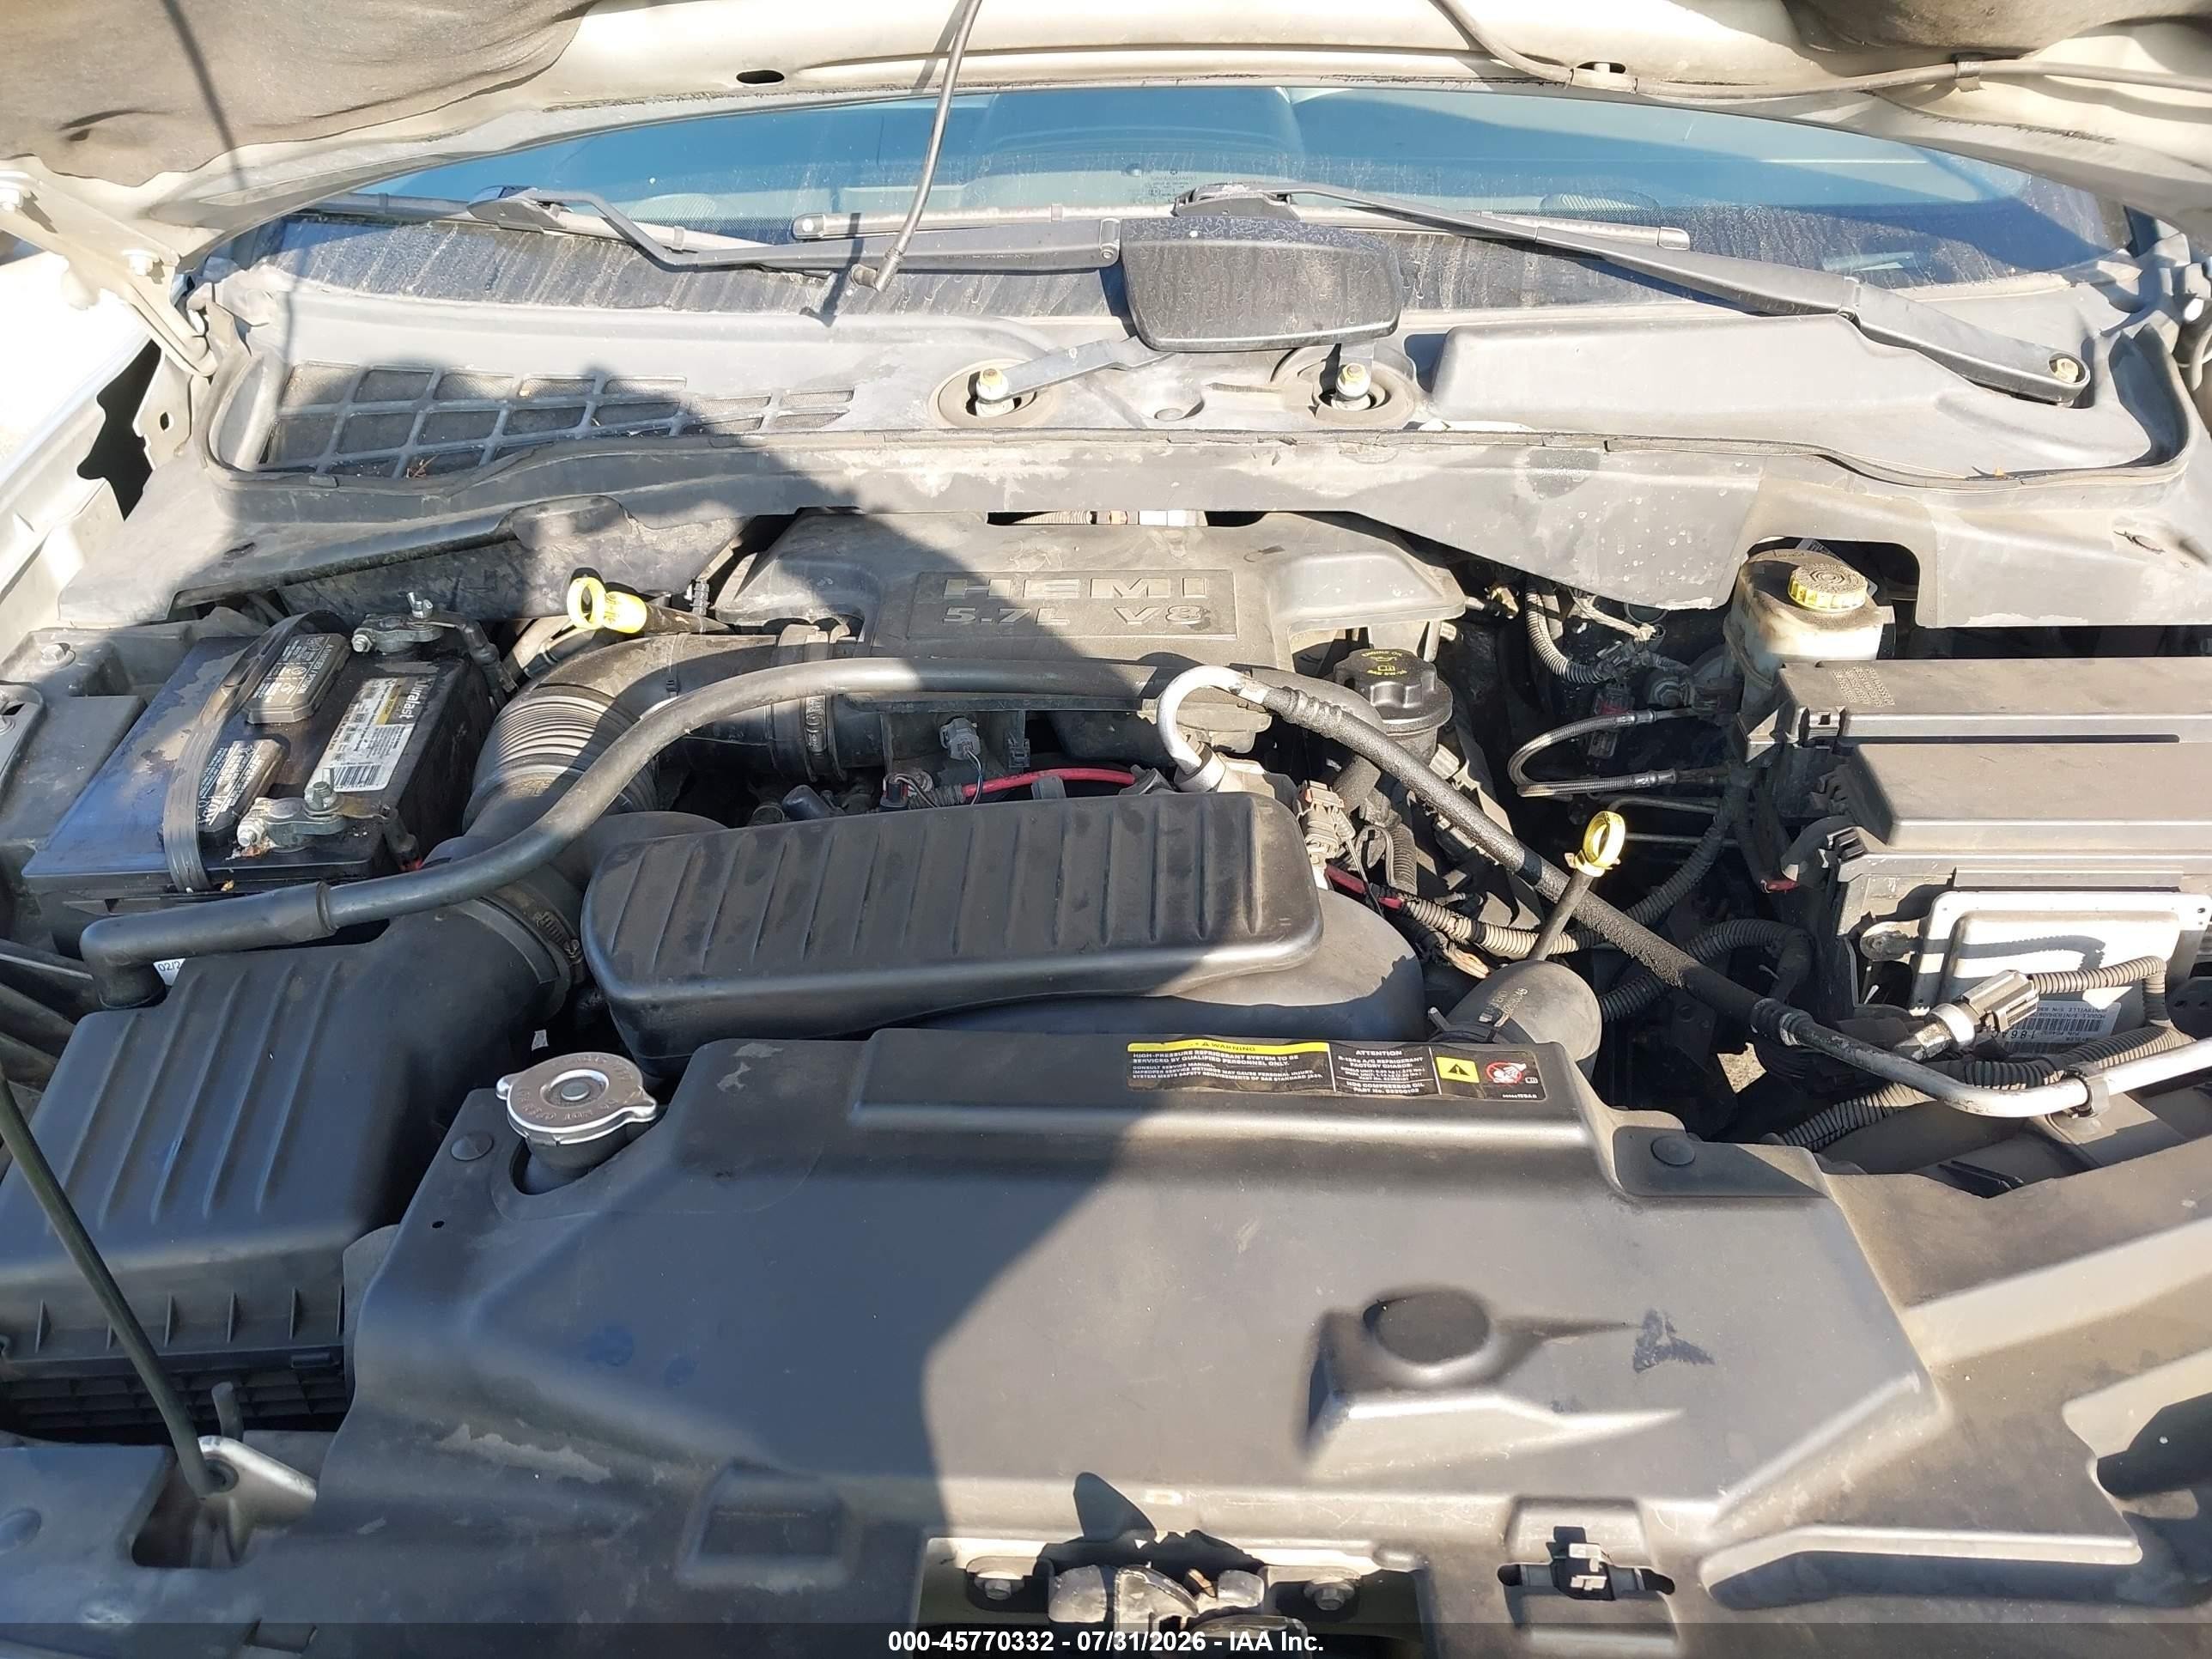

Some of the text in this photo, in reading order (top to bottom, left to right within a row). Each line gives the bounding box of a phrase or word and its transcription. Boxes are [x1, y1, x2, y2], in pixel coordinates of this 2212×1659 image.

[943, 577, 1207, 599] HEMI
[943, 605, 1204, 626] 5.7L V8
[1133, 1050, 1194, 1059] HIGH-PRESSURE
[1194, 1049, 1245, 1060] REFRIGERANT
[1212, 1042, 1255, 1052] WARNING
